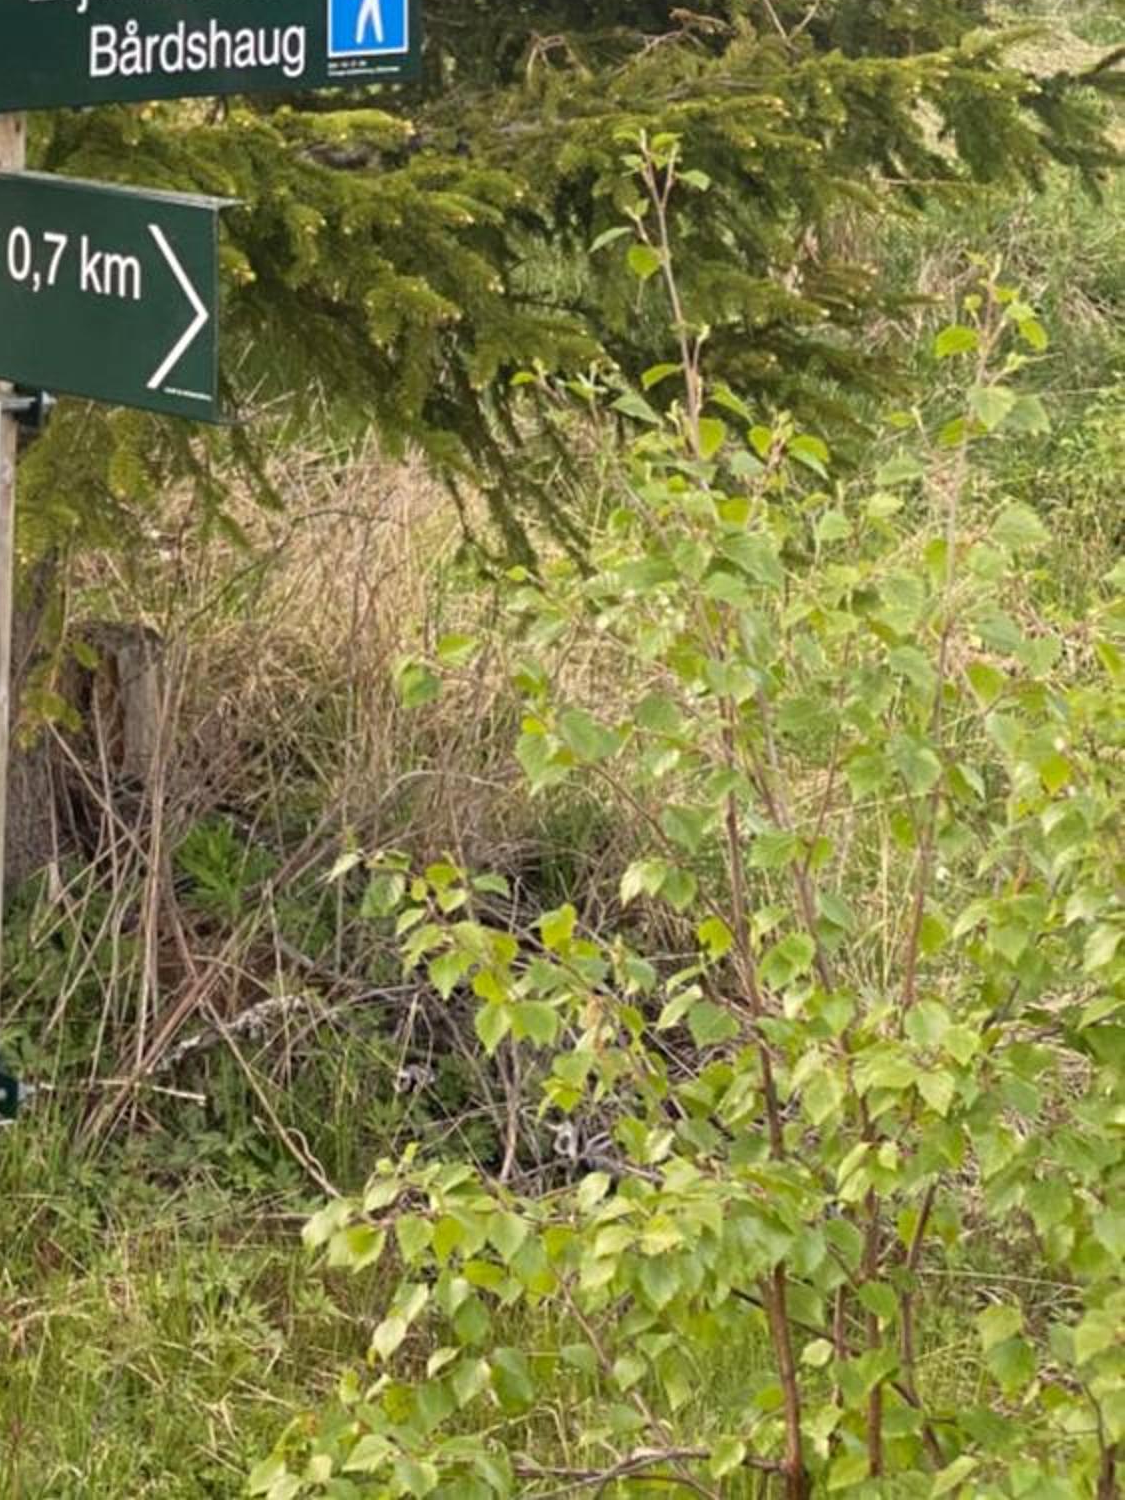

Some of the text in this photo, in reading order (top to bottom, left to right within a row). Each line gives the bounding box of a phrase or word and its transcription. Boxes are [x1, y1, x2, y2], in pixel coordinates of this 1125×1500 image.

[90, 19, 305, 77] Bårdshaug
[7, 226, 68, 292] 0,7
[80, 235, 141, 300] km
